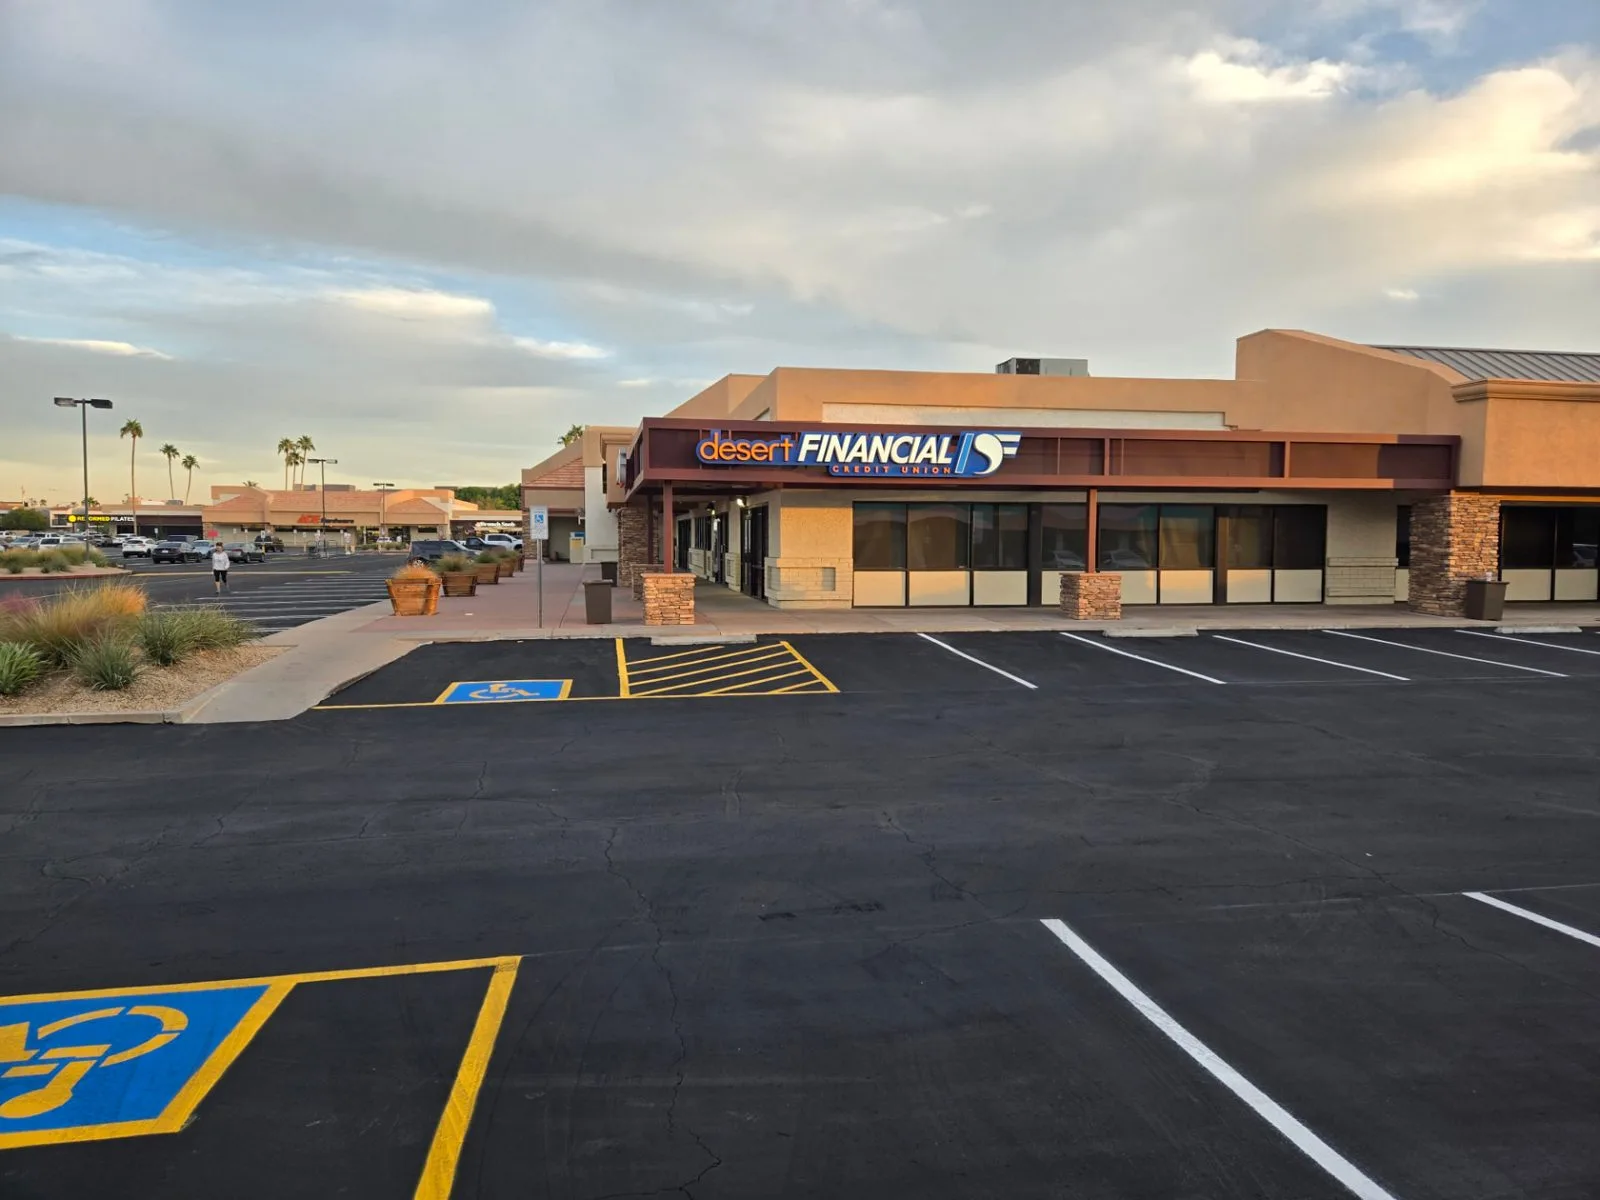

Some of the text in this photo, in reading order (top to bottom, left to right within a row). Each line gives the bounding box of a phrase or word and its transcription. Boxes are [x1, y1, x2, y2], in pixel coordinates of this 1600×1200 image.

[700, 432, 952, 464] desert FINANCIAL
[832, 465, 951, 474] CREDIT UNION
